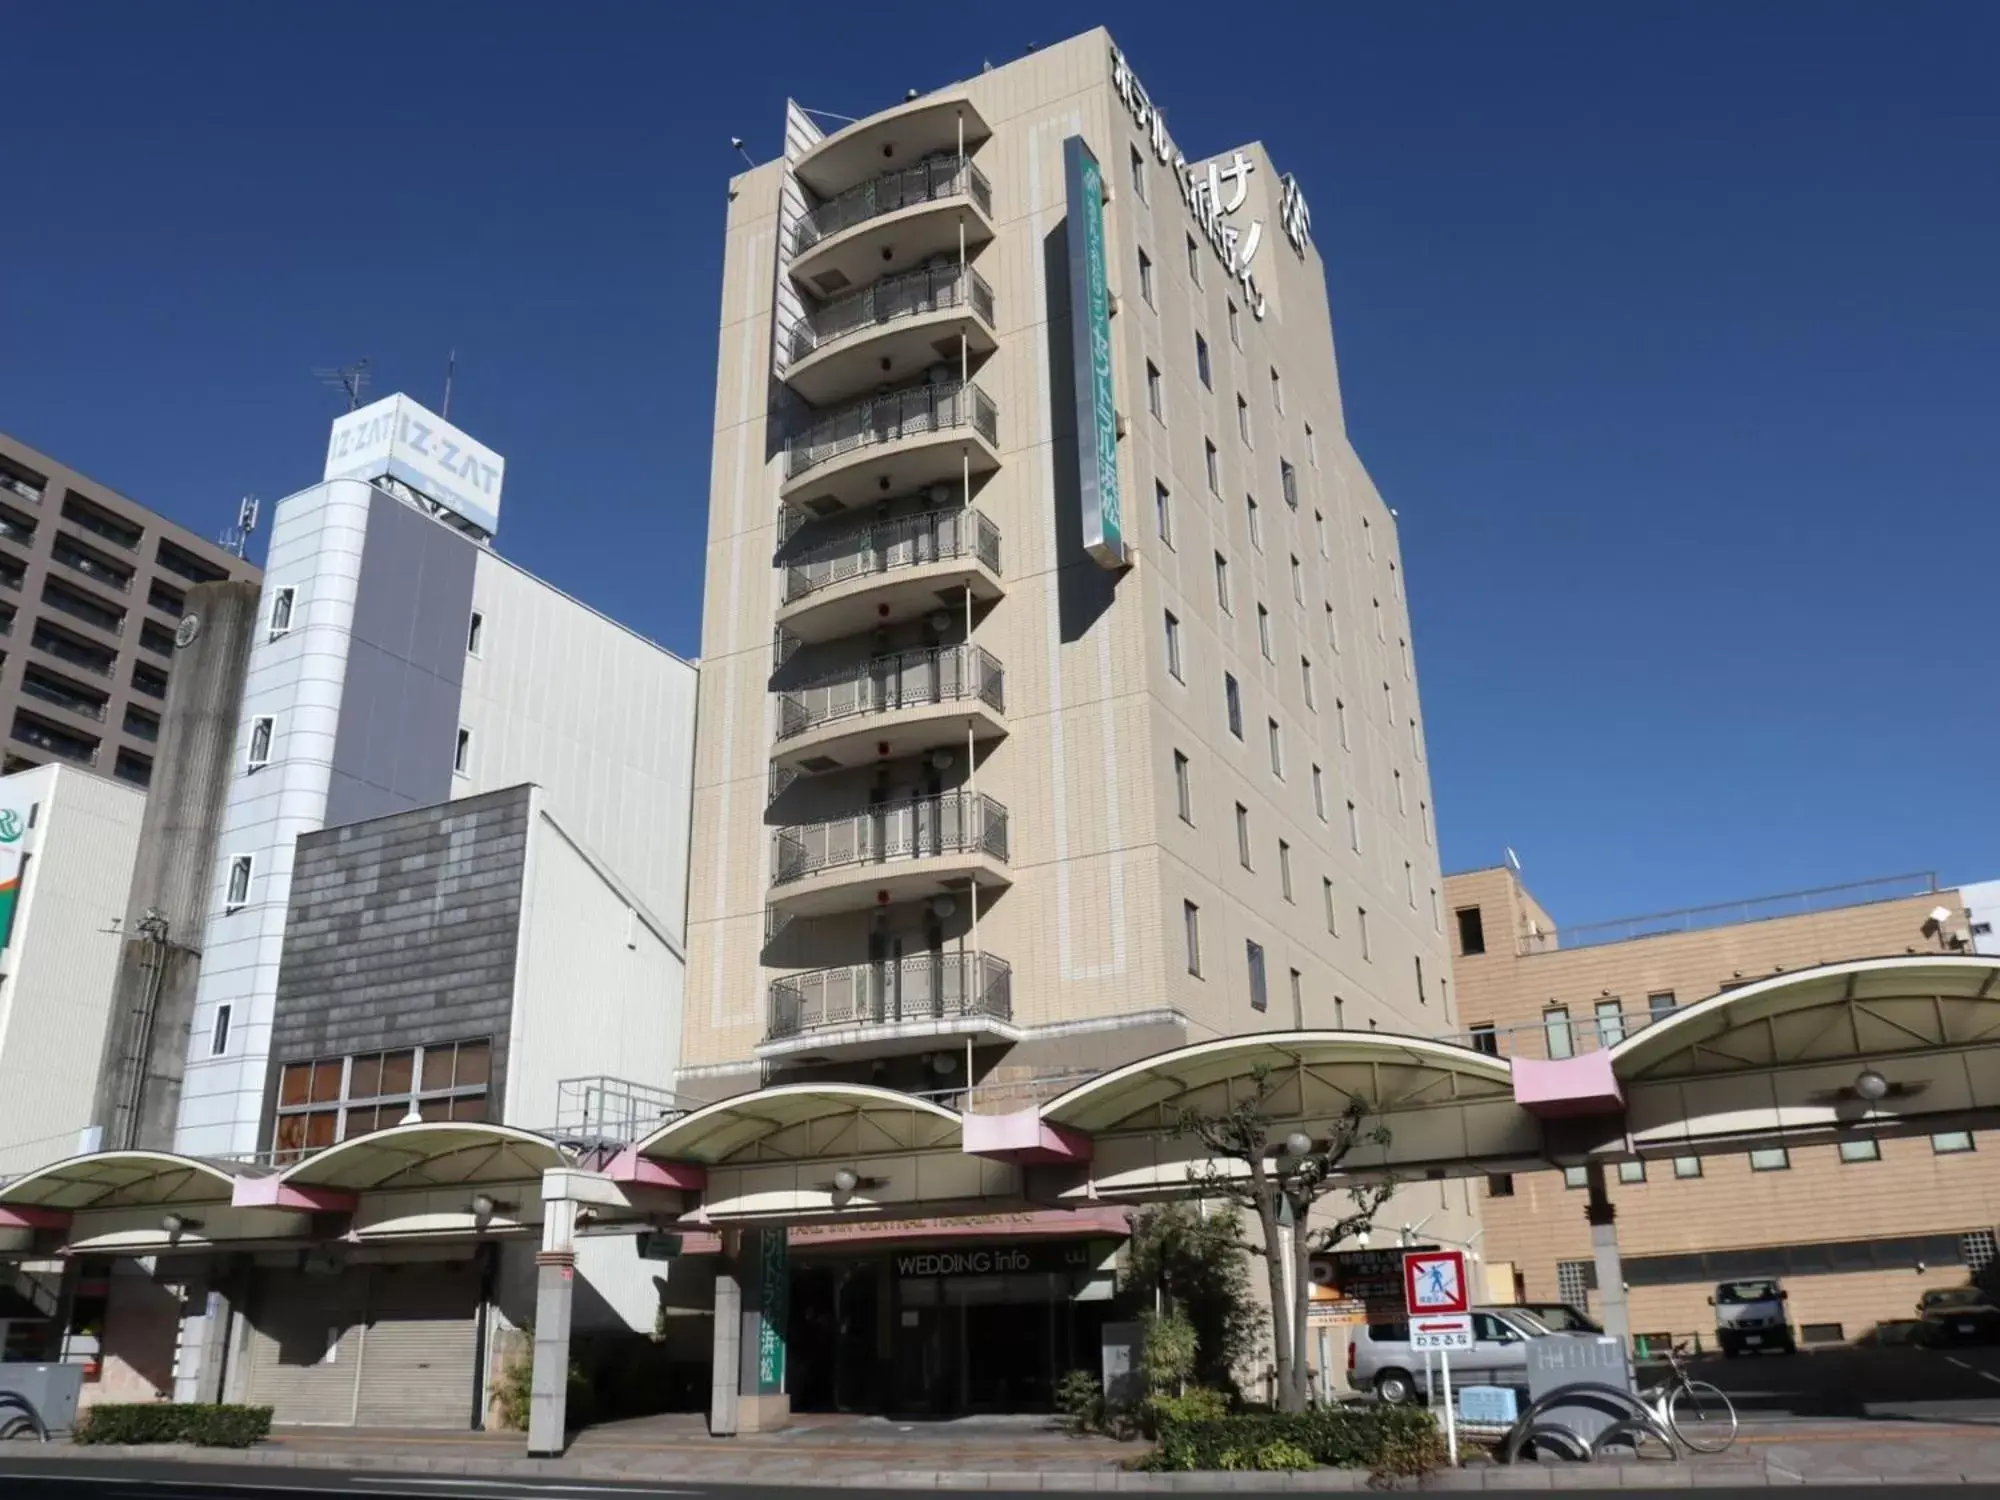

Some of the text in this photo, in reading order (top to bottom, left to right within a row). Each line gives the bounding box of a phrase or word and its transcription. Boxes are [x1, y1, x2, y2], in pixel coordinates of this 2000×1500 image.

[898, 1250, 1030, 1275] WEDDING info
[1416, 1334, 1467, 1346] わたるな
